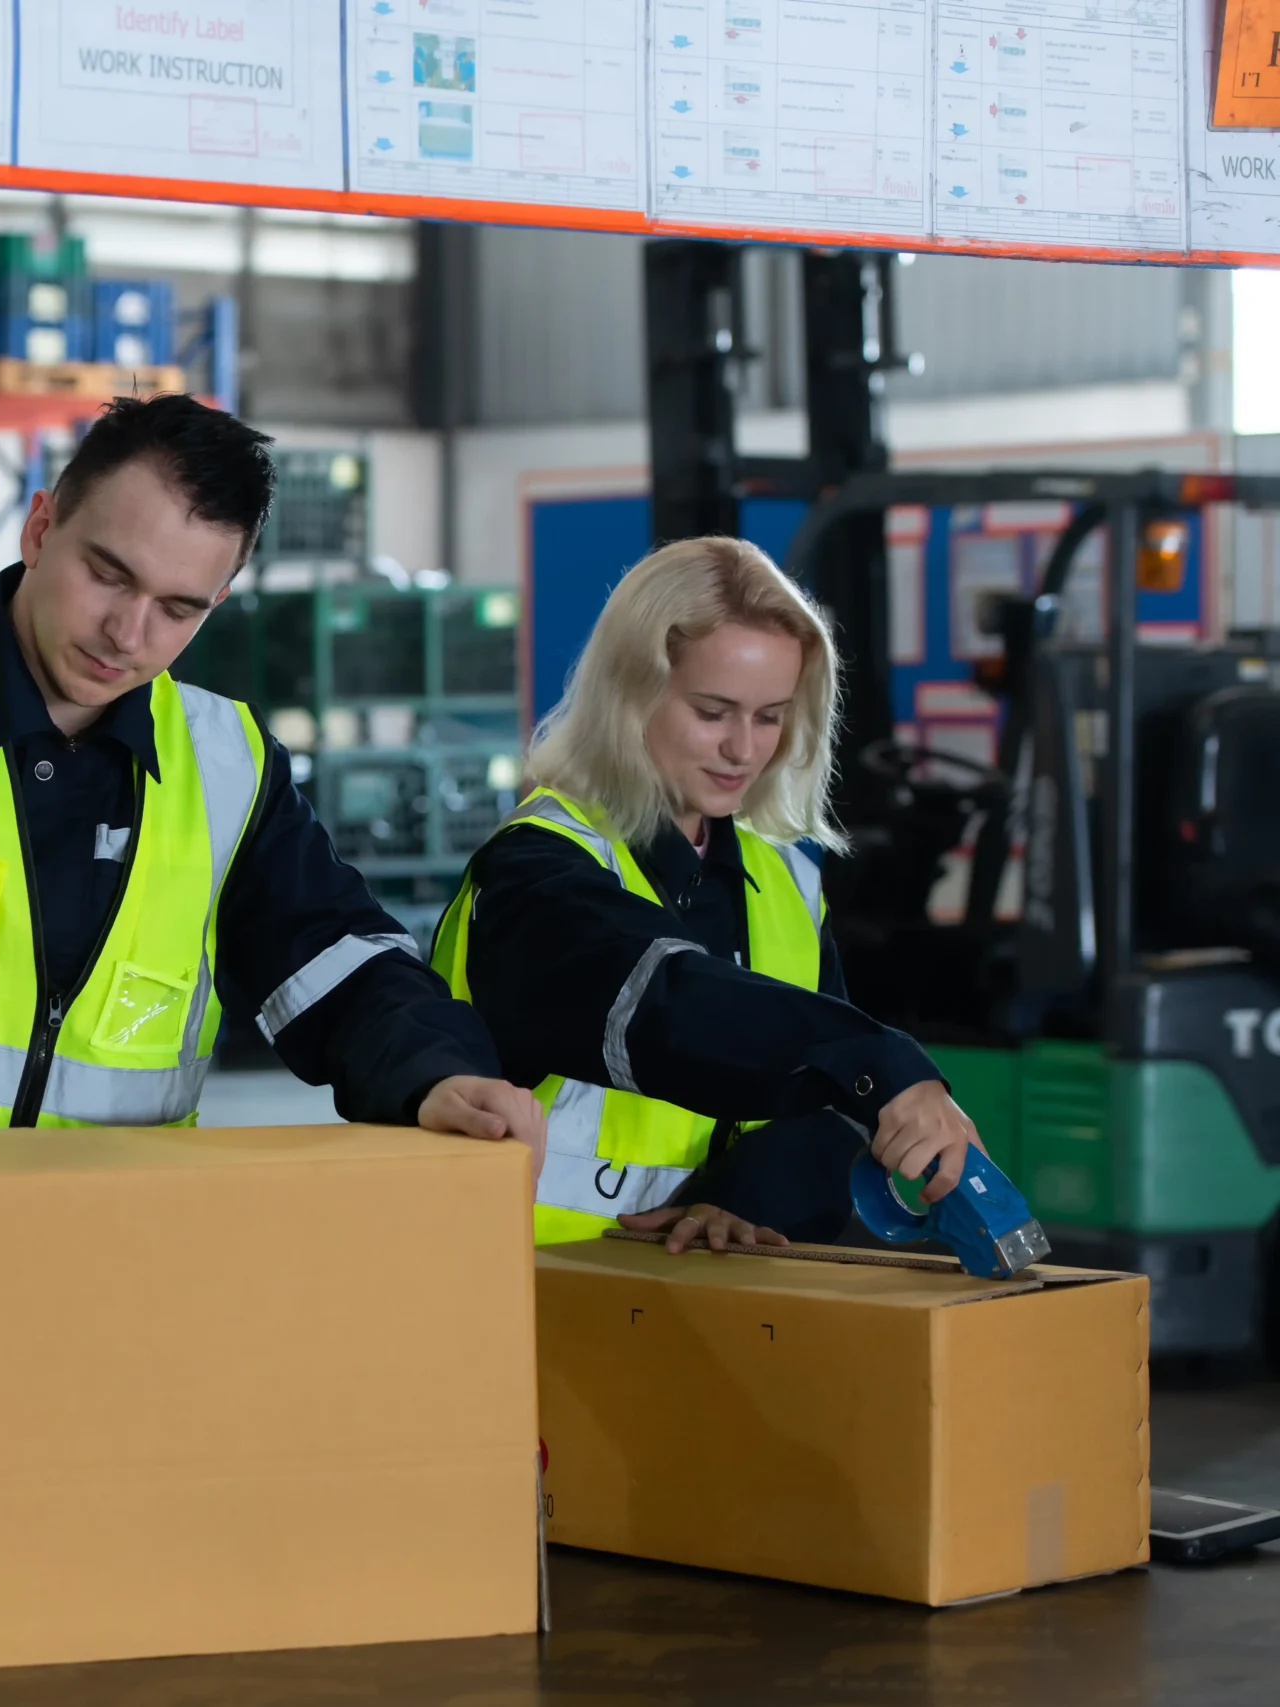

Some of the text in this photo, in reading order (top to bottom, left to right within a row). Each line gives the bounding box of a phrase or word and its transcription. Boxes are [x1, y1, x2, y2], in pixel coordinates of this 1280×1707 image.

[115, 6, 244, 42] Identify Label
[78, 47, 284, 91] WORK INSTRUCTION
[1221, 155, 1276, 181] WORK
